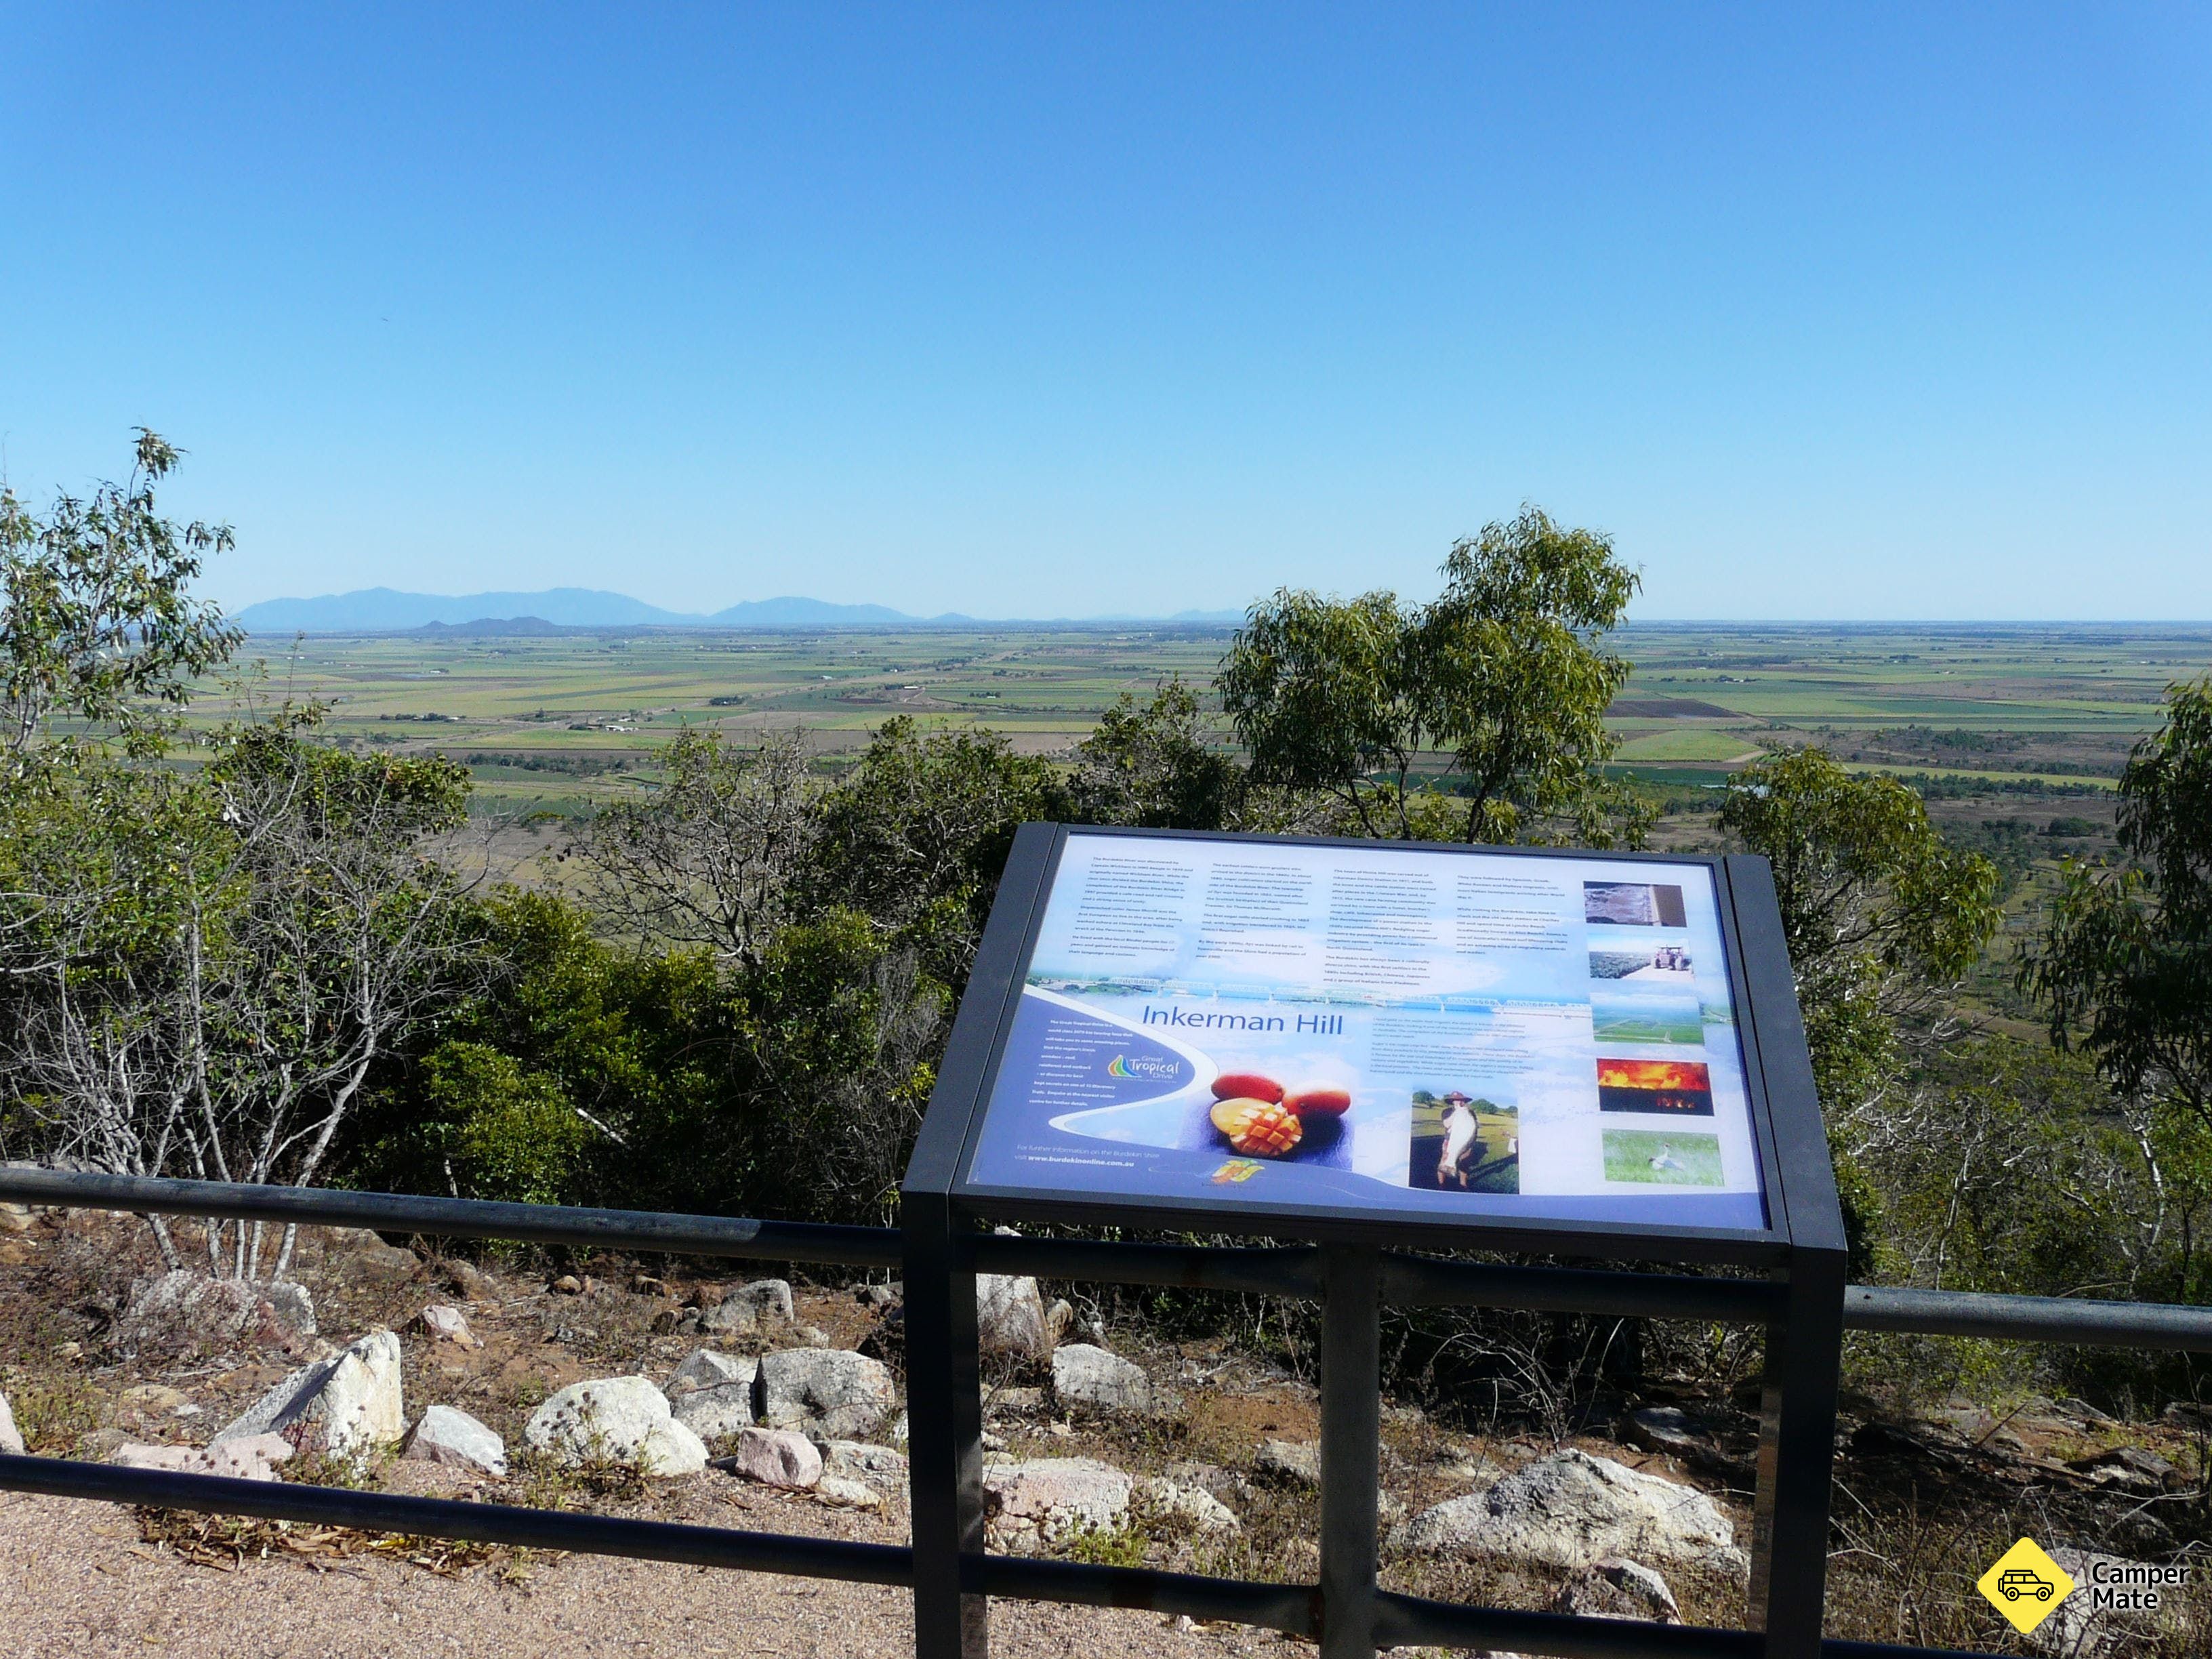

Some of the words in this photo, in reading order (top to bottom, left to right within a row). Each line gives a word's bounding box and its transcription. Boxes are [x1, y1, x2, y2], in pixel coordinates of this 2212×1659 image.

[1143, 1005, 1285, 1032] Inkerman
[1296, 1014, 1343, 1035] Hill
[1130, 1059, 1180, 1075] Tropical
[1028, 1155, 1134, 1167] www.burdekinonline.com.au
